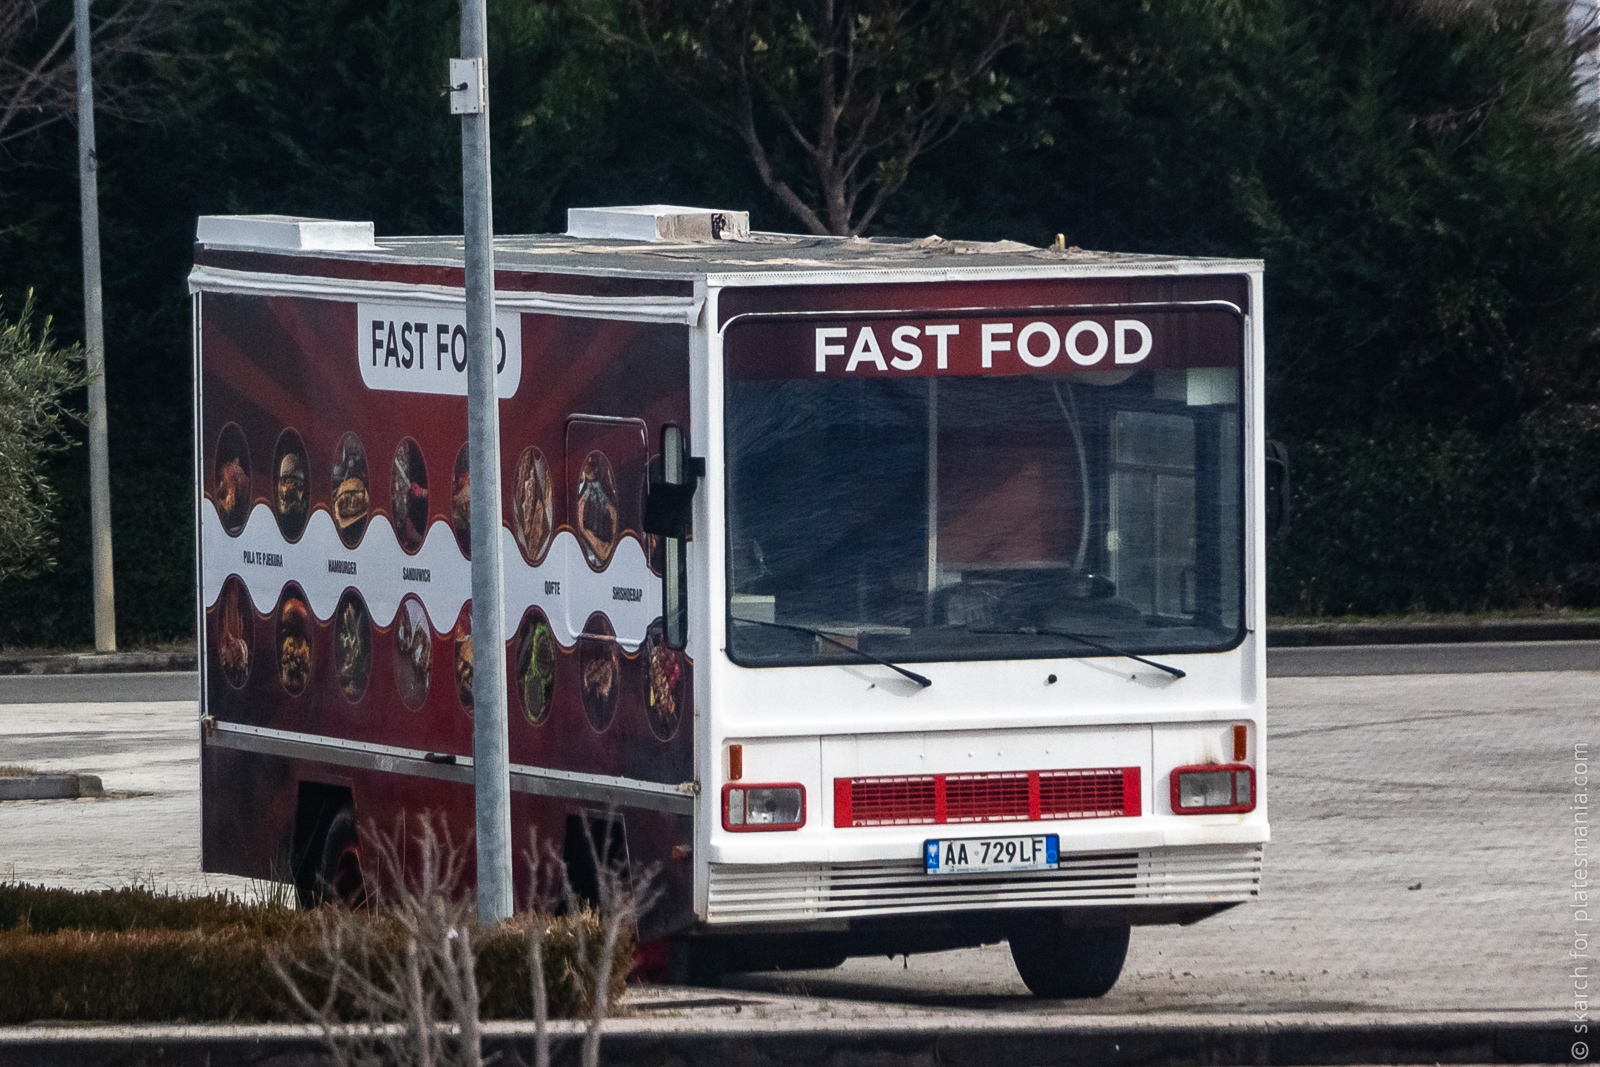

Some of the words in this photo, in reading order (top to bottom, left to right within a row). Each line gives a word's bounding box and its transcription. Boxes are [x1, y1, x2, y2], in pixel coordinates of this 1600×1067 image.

[372, 320, 428, 369] FAST
[436, 323, 507, 374] FOD
[815, 325, 960, 372] FAST
[981, 319, 1153, 368] FOOD
[328, 560, 357, 575] HAMBURGER
[545, 580, 560, 595] QOFTE
[945, 843, 969, 865] AA
[981, 838, 1043, 864] 729LF
